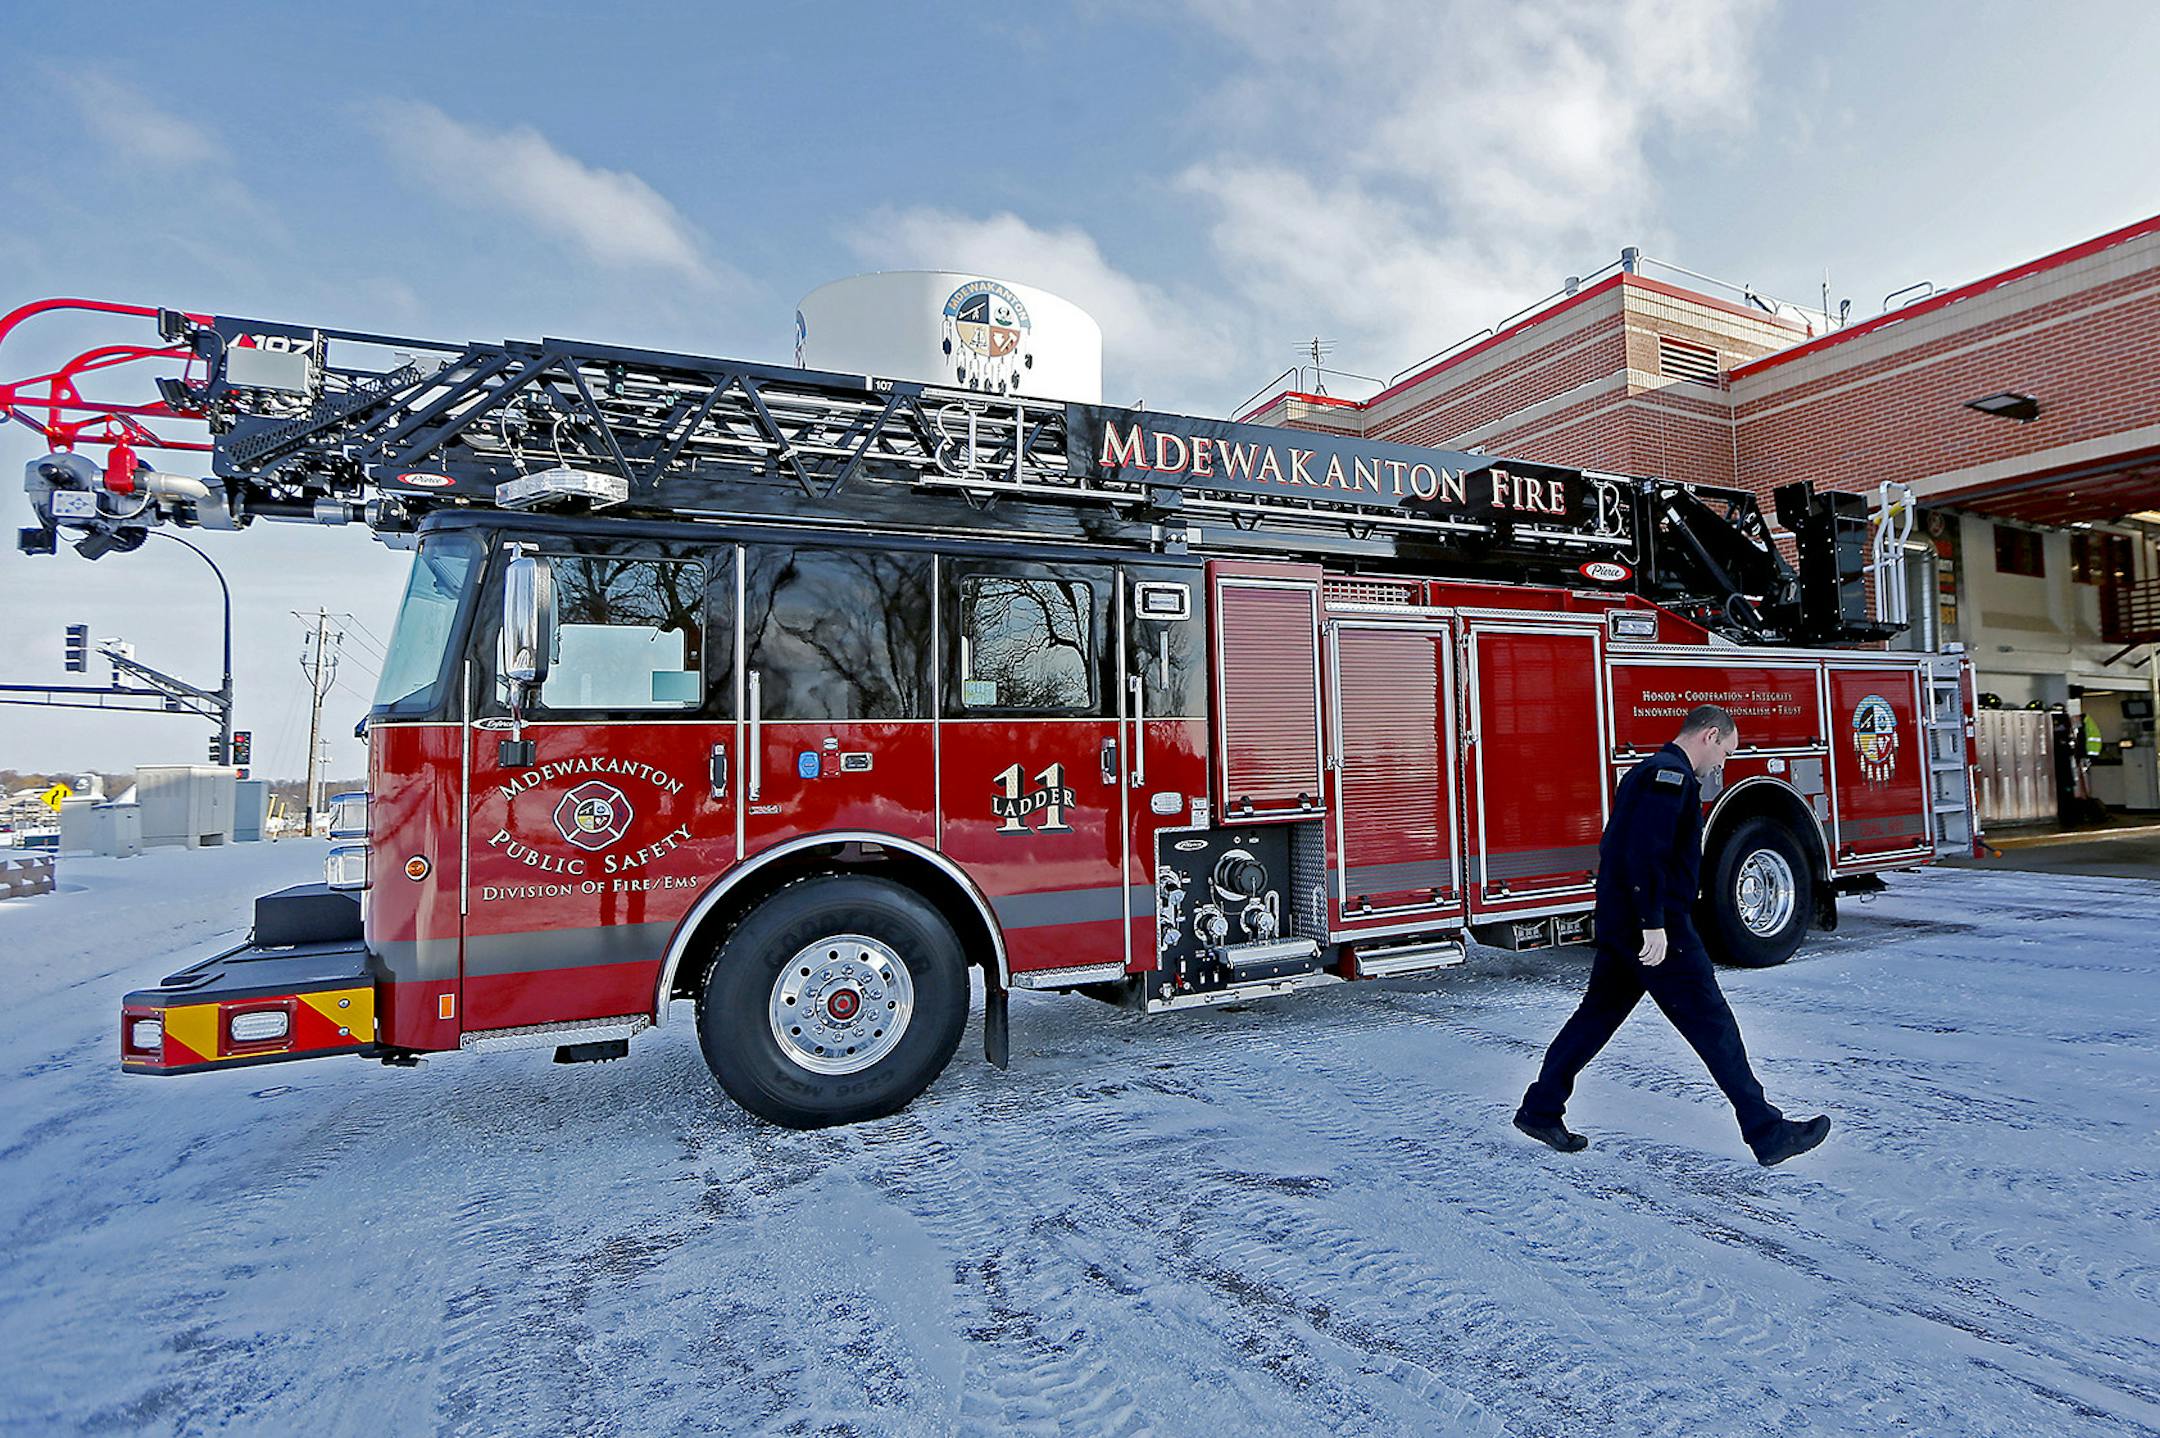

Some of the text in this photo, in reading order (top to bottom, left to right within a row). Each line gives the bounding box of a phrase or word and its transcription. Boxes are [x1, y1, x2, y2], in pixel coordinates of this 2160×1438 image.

[949, 281, 1029, 322] MDEWAKANTON
[874, 380, 894, 391] 107
[1099, 420, 1567, 515] MDEWAKANTON FIRE
[1591, 564, 1621, 577] Pierce
[1633, 706, 1689, 717] INNOVATION
[1778, 704, 1801, 716] TRUST
[1642, 690, 1793, 702] HONOR COOPERATION INTEGRITY
[499, 757, 684, 801] MDEWAKANTON
[992, 788, 1075, 817] LADDER
[993, 762, 1073, 835] 11
[487, 823, 693, 876] PUBLIC SAFETY
[482, 875, 698, 902] DIVISION OF FIRE/EMS
